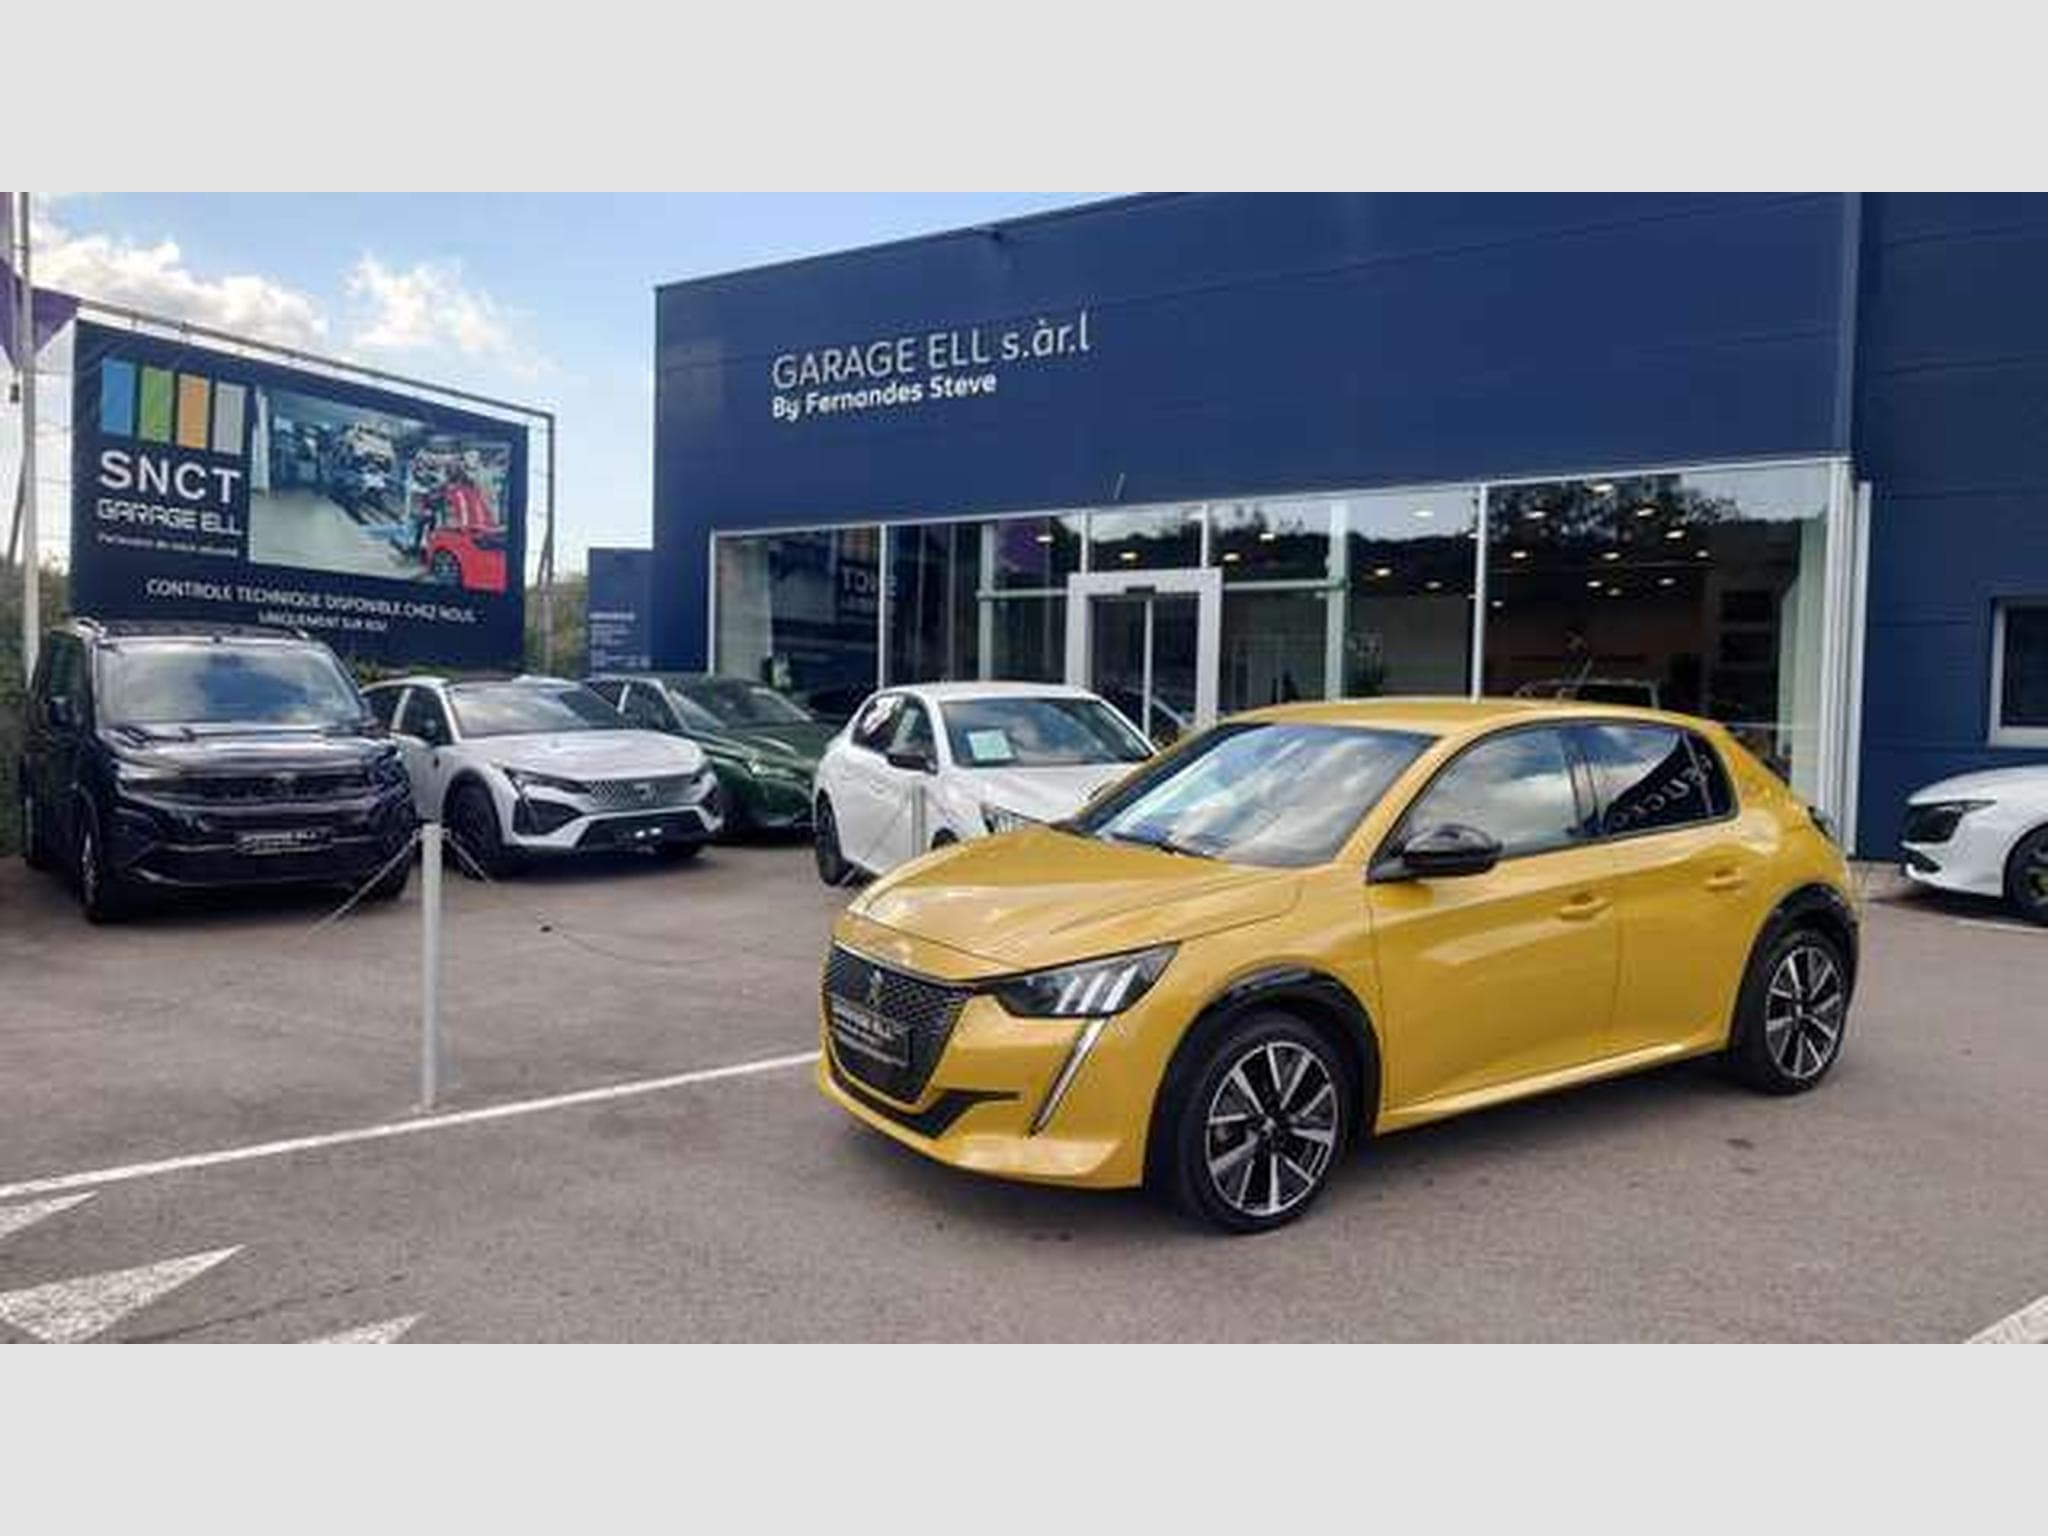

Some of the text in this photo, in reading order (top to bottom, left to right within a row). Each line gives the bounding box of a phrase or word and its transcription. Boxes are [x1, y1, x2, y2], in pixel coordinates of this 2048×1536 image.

[771, 338, 916, 390] GARAGE
[927, 328, 991, 371] ELL
[772, 371, 997, 422] By Fernandes Steve
[99, 449, 242, 504] SNCT
[97, 498, 199, 530] GARAGE
